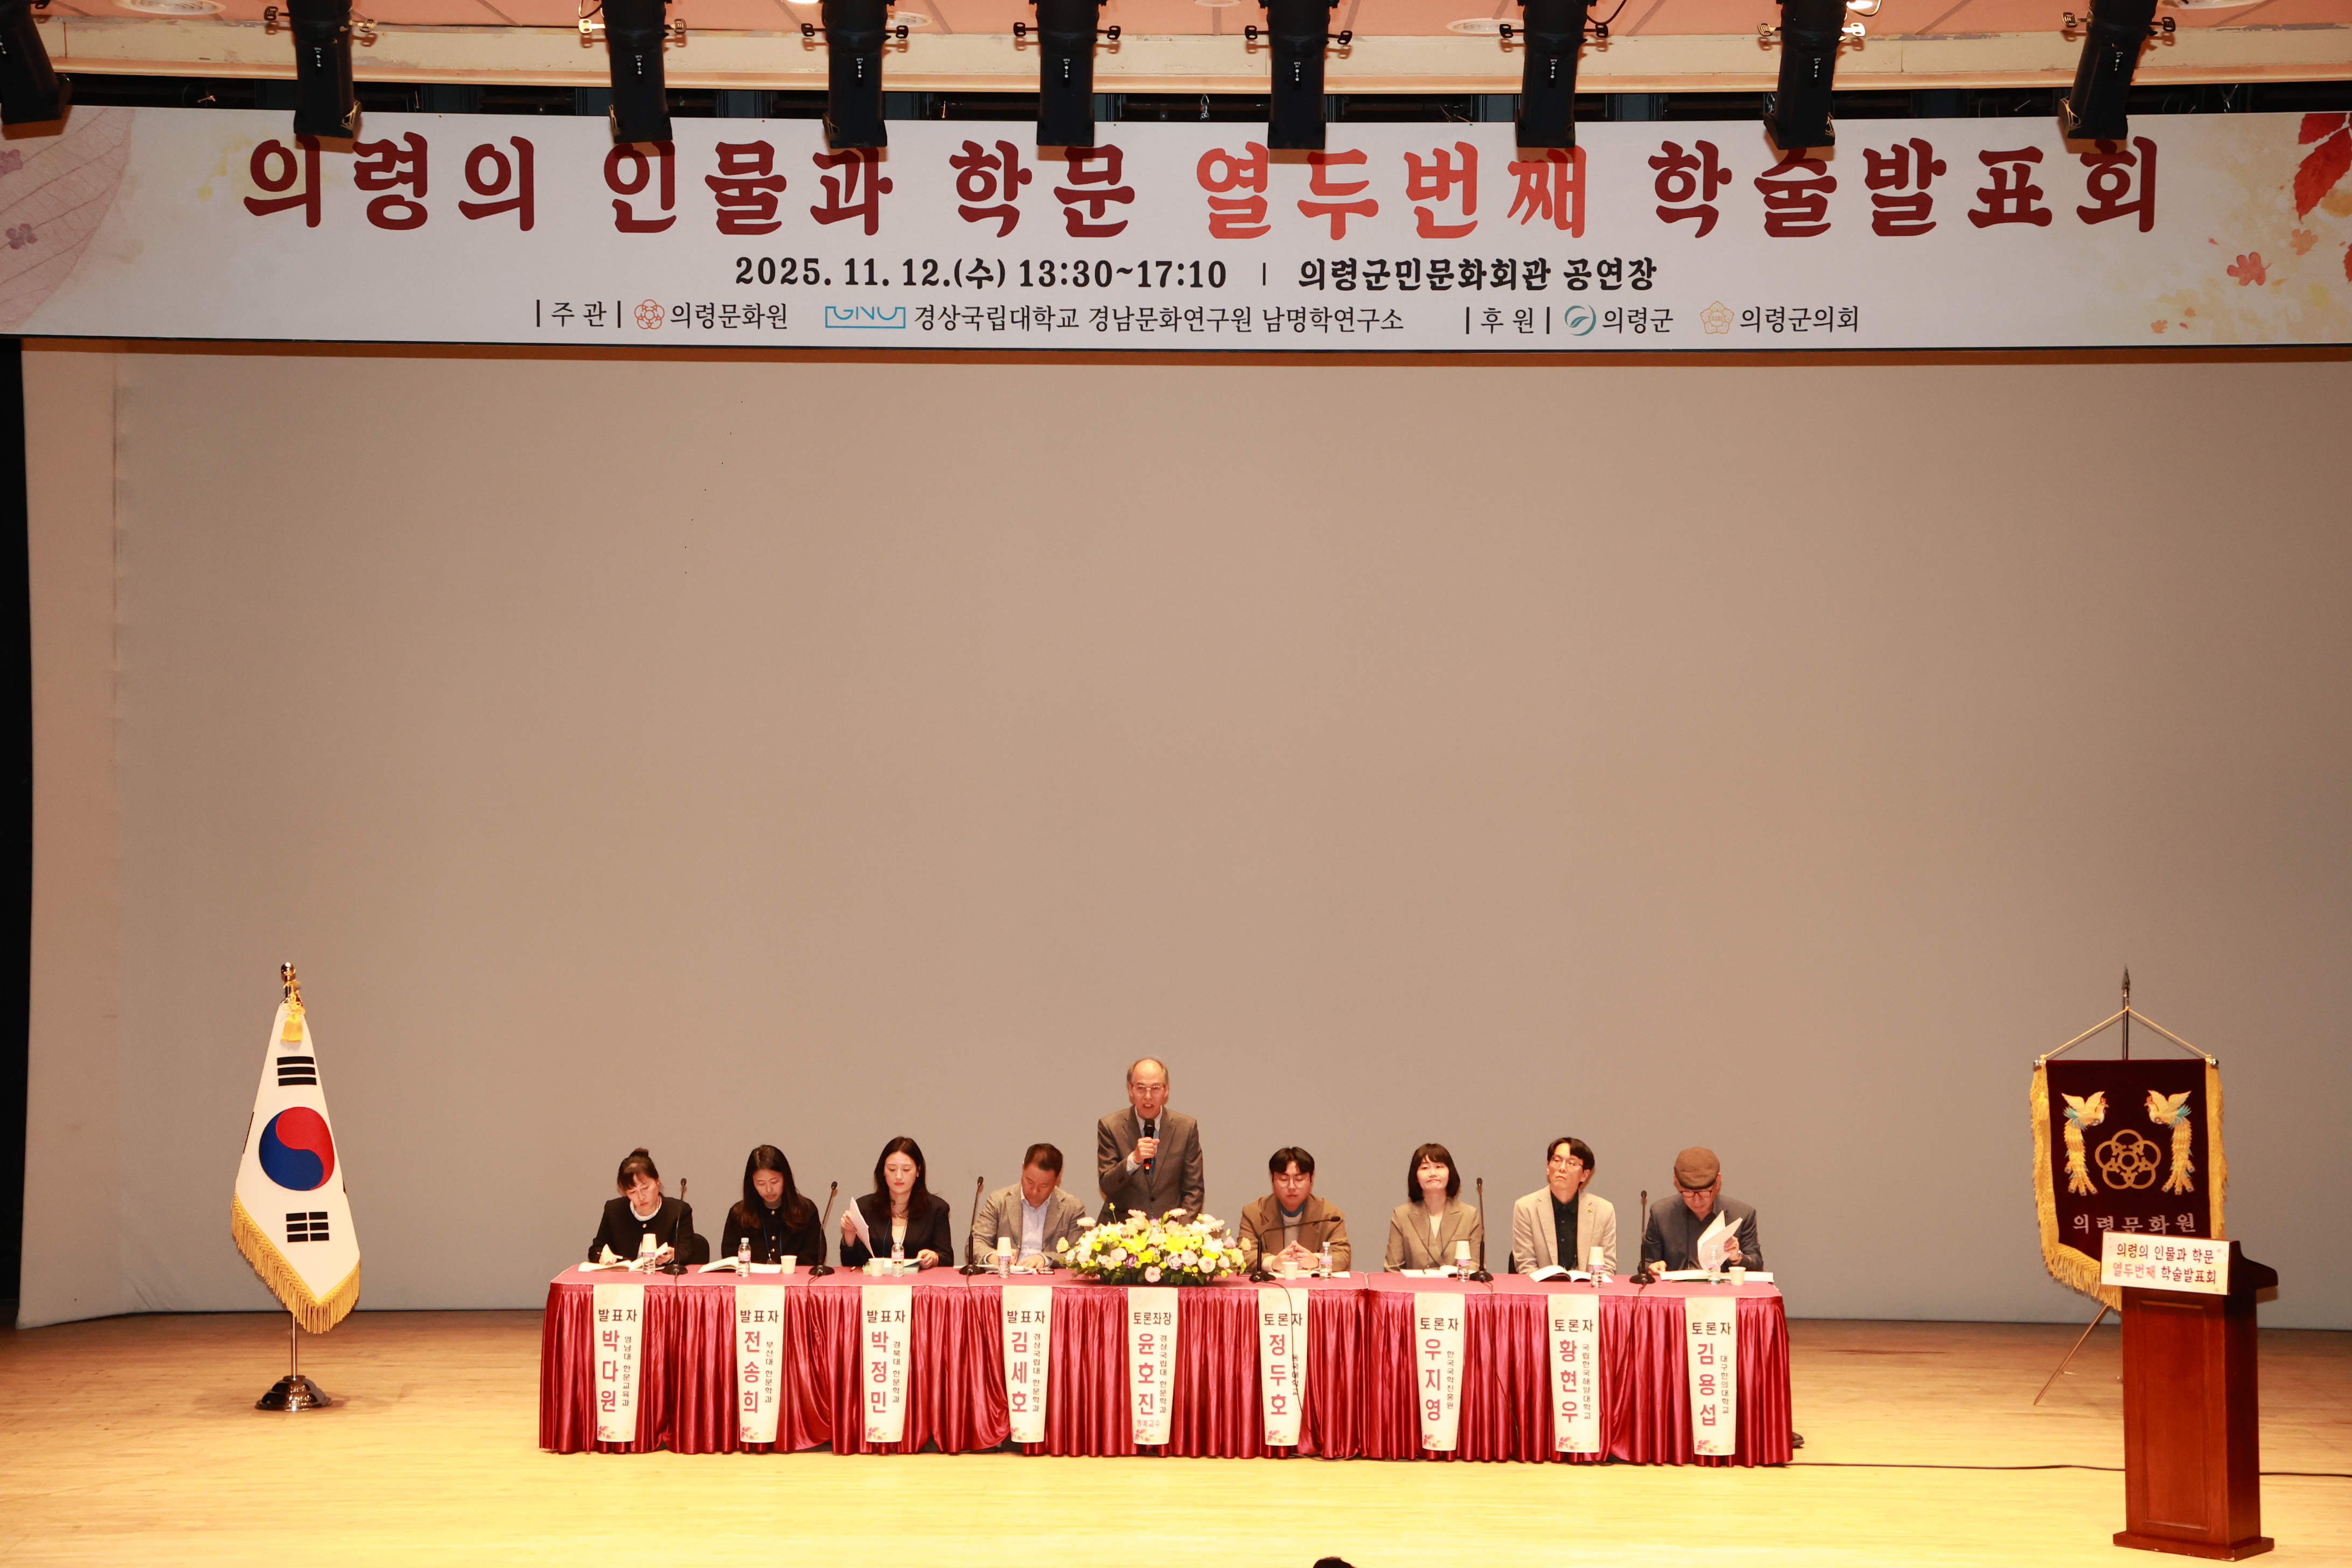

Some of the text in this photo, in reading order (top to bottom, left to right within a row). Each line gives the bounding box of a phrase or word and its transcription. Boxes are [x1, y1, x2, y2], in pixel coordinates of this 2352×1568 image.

[245, 132, 2155, 240] 의령의 인물과 학문 열두번째 학술발표회
[736, 257, 1657, 291] 2025. 11. 12.(수) 13:30~17:10 의령군민문화회관 공연장
[670, 302, 787, 329] 의령문화원
[825, 306, 905, 321] GNU
[915, 304, 1404, 333] 경상국립대학교 경남문화연구원 남명학연구소
[1602, 307, 1674, 333] 의령군
[1740, 306, 1858, 333] 의령군의회
[2073, 1213, 2196, 1234] 의령문화원
[2117, 1243, 2214, 1264] 의령의 인물과 학문
[2113, 1262, 2216, 1284] 열두번째 학술발표회
[598, 1309, 637, 1322] 발표자
[740, 1310, 779, 1323] 발표자
[867, 1310, 905, 1323] 발표자
[1007, 1311, 1045, 1324] 발표자
[1133, 1312, 1172, 1325] 토론좌장
[1264, 1313, 1303, 1326] 토론자
[1420, 1318, 1458, 1331] 토론자
[1555, 1319, 1593, 1332] 토론자
[1692, 1322, 1731, 1335] 토론자
[624, 1336, 632, 1360] 영남대
[601, 1330, 619, 1412] 박다원
[744, 1331, 760, 1413] 전송희
[871, 1331, 888, 1413] 박정민
[1011, 1331, 1027, 1412] 김세호
[1138, 1333, 1154, 1415] 윤호진
[1270, 1334, 1287, 1415] 정두호
[1425, 1339, 1441, 1421] 우지영
[1446, 1350, 1454, 1410] 한국국학진흥원
[1559, 1340, 1578, 1423] 황현우
[1697, 1343, 1716, 1426] 김용섭
[1720, 1355, 1729, 1413] 대구한의대학교
[765, 1370, 773, 1403] 한문학과
[1032, 1379, 1040, 1412] 한문학과
[1137, 1419, 1160, 1428] 명예교수
